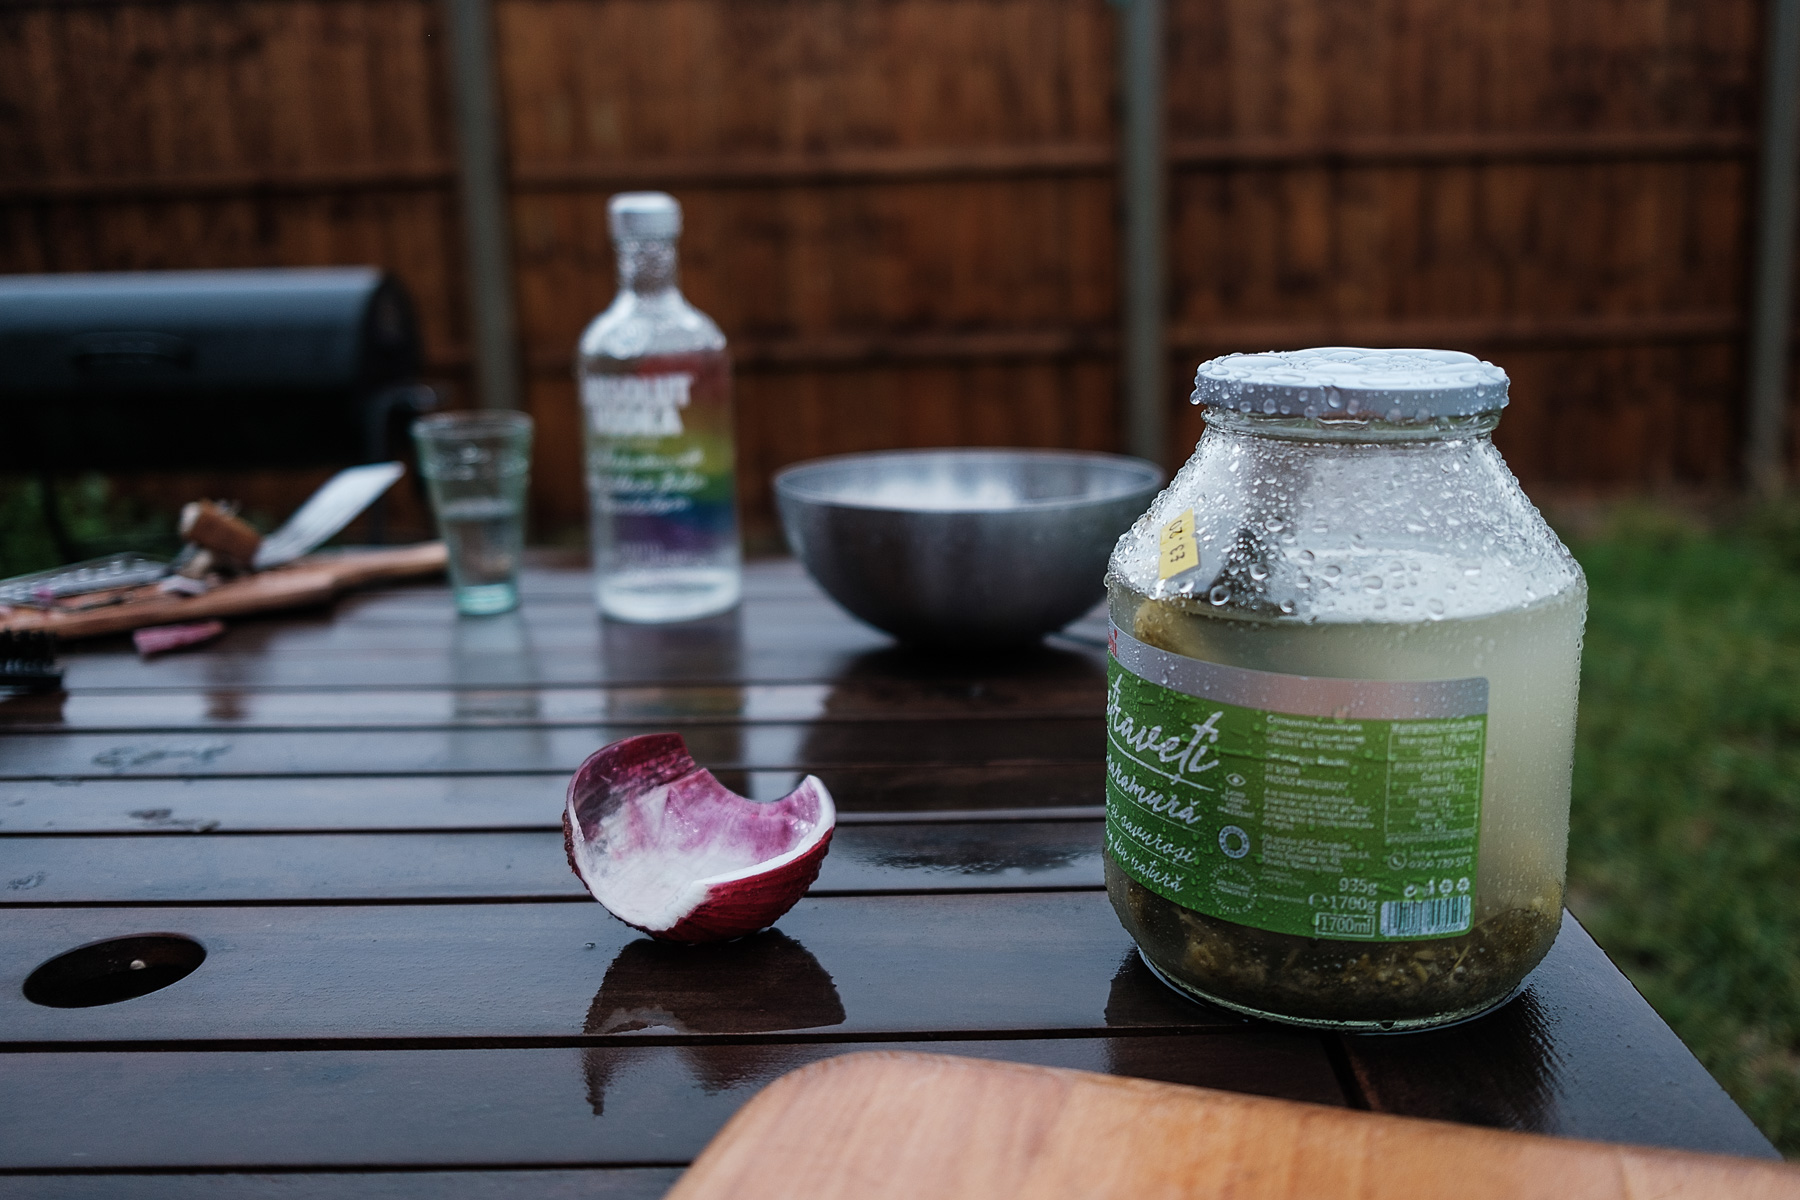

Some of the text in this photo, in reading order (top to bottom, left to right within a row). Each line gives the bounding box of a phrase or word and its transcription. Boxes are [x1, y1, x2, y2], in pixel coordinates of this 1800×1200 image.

[1169, 520, 1185, 562] £3.20
[1339, 877, 1378, 896] 935g
[1330, 895, 1377, 914] 1700g
[1321, 916, 1371, 933] 1700ml
